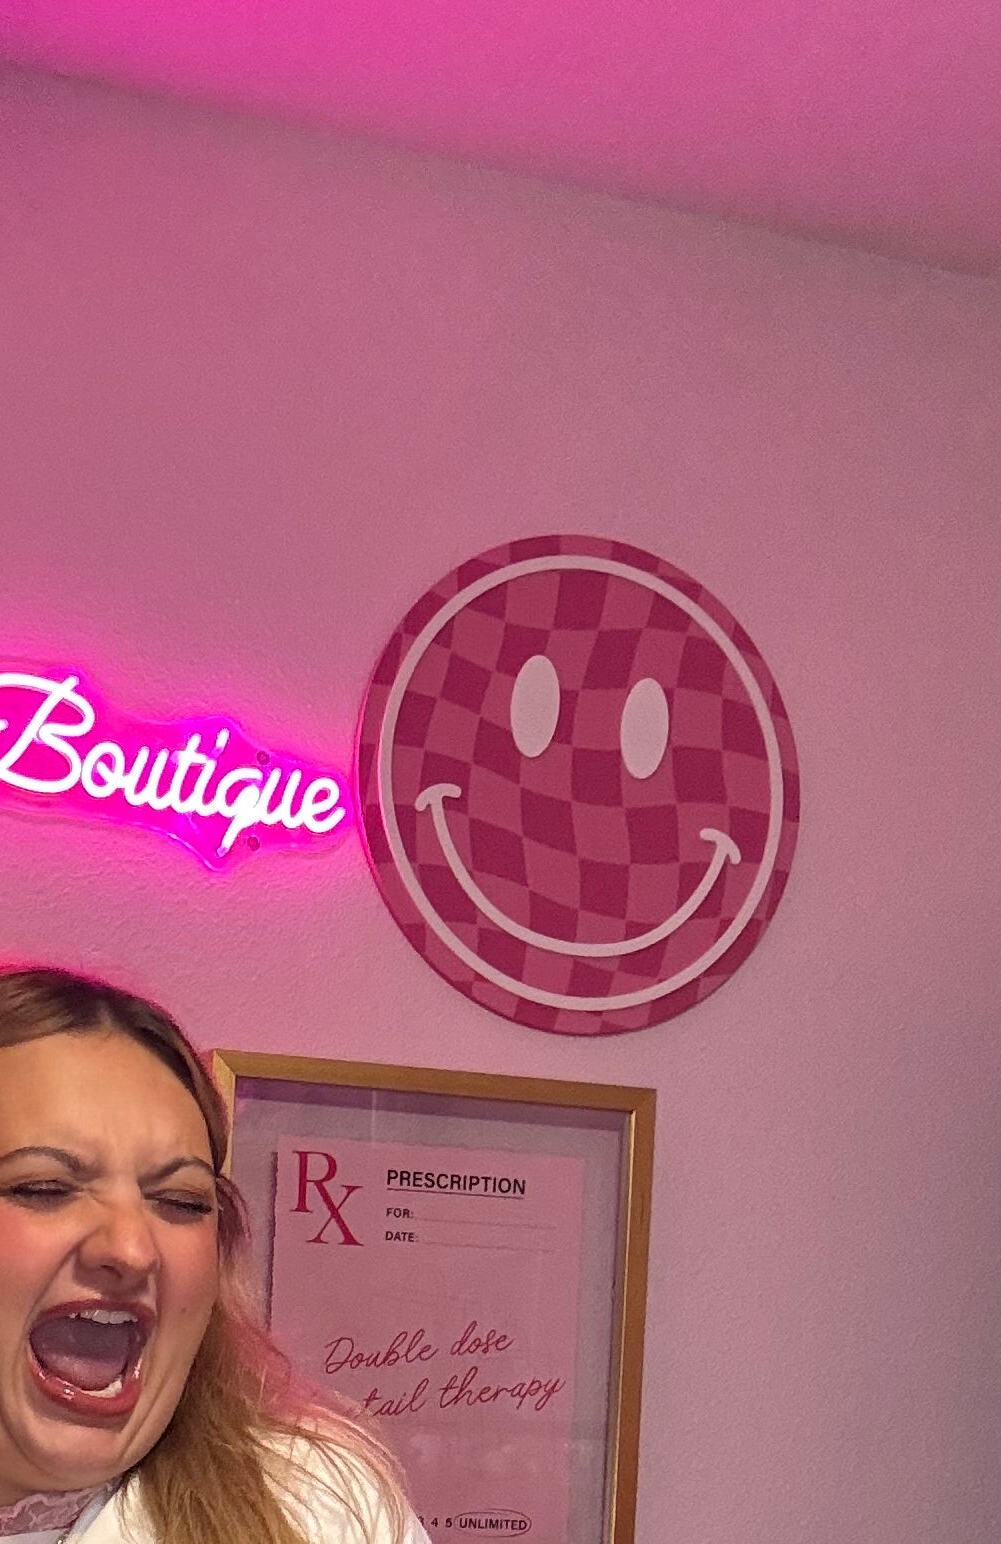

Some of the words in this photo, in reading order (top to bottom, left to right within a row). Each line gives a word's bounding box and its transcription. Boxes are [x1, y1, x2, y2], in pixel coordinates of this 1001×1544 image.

[386, 1169, 527, 1196] PRESCRIPTION
[324, 1329, 439, 1374] Double
[449, 1320, 514, 1357] dose
[362, 1379, 429, 1417] tail
[438, 1366, 566, 1412] therapy
[430, 1516, 439, 1528] 4
[444, 1516, 453, 1528] 5
[458, 1517, 528, 1531] UNLIMITED
